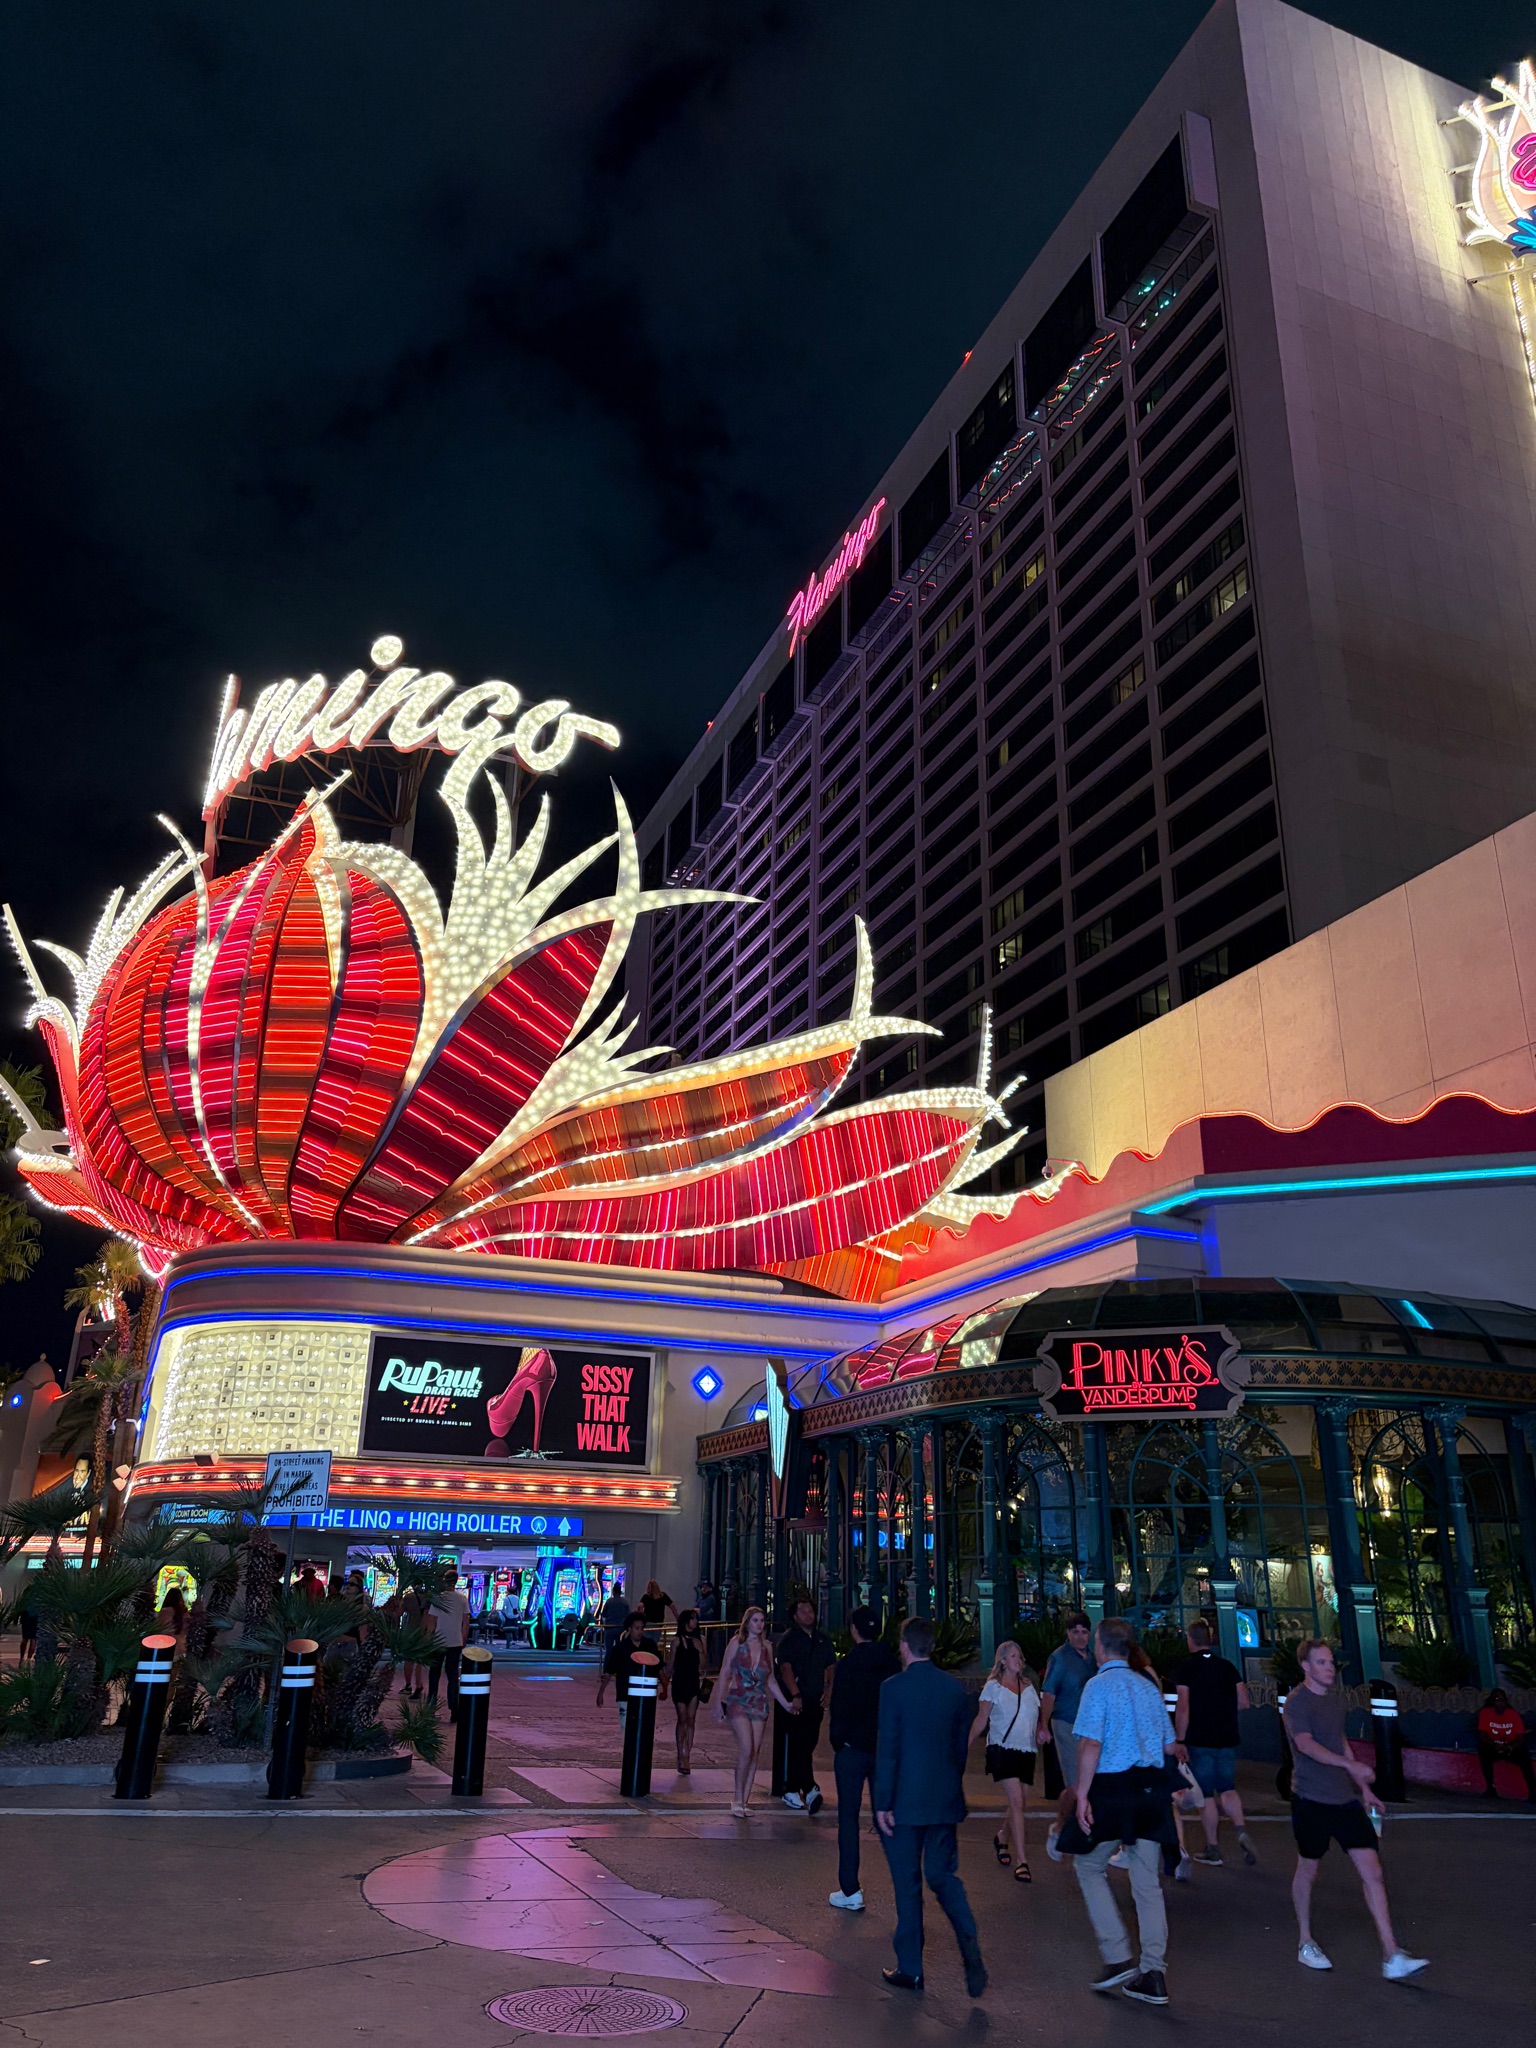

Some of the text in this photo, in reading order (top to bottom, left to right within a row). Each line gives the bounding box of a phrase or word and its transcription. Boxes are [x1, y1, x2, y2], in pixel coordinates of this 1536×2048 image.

[1069, 1334, 1212, 1388] PINKY'S
[378, 1358, 483, 1394] RuPaul's
[581, 1364, 634, 1394] SISSY
[423, 1386, 480, 1398] DRAG RACE
[1081, 1387, 1198, 1405] VANDERPUMP
[410, 1395, 451, 1415] LIVE
[582, 1394, 630, 1423] THAT
[577, 1422, 631, 1453] WALK
[274, 1457, 324, 1467] ON-STREET PARKING
[265, 1494, 324, 1508] PROHIBITED
[190, 1509, 208, 1517] ROOM
[349, 1509, 391, 1530] LINQ
[408, 1511, 451, 1531] HIGH
[456, 1513, 521, 1534] ROLLER
